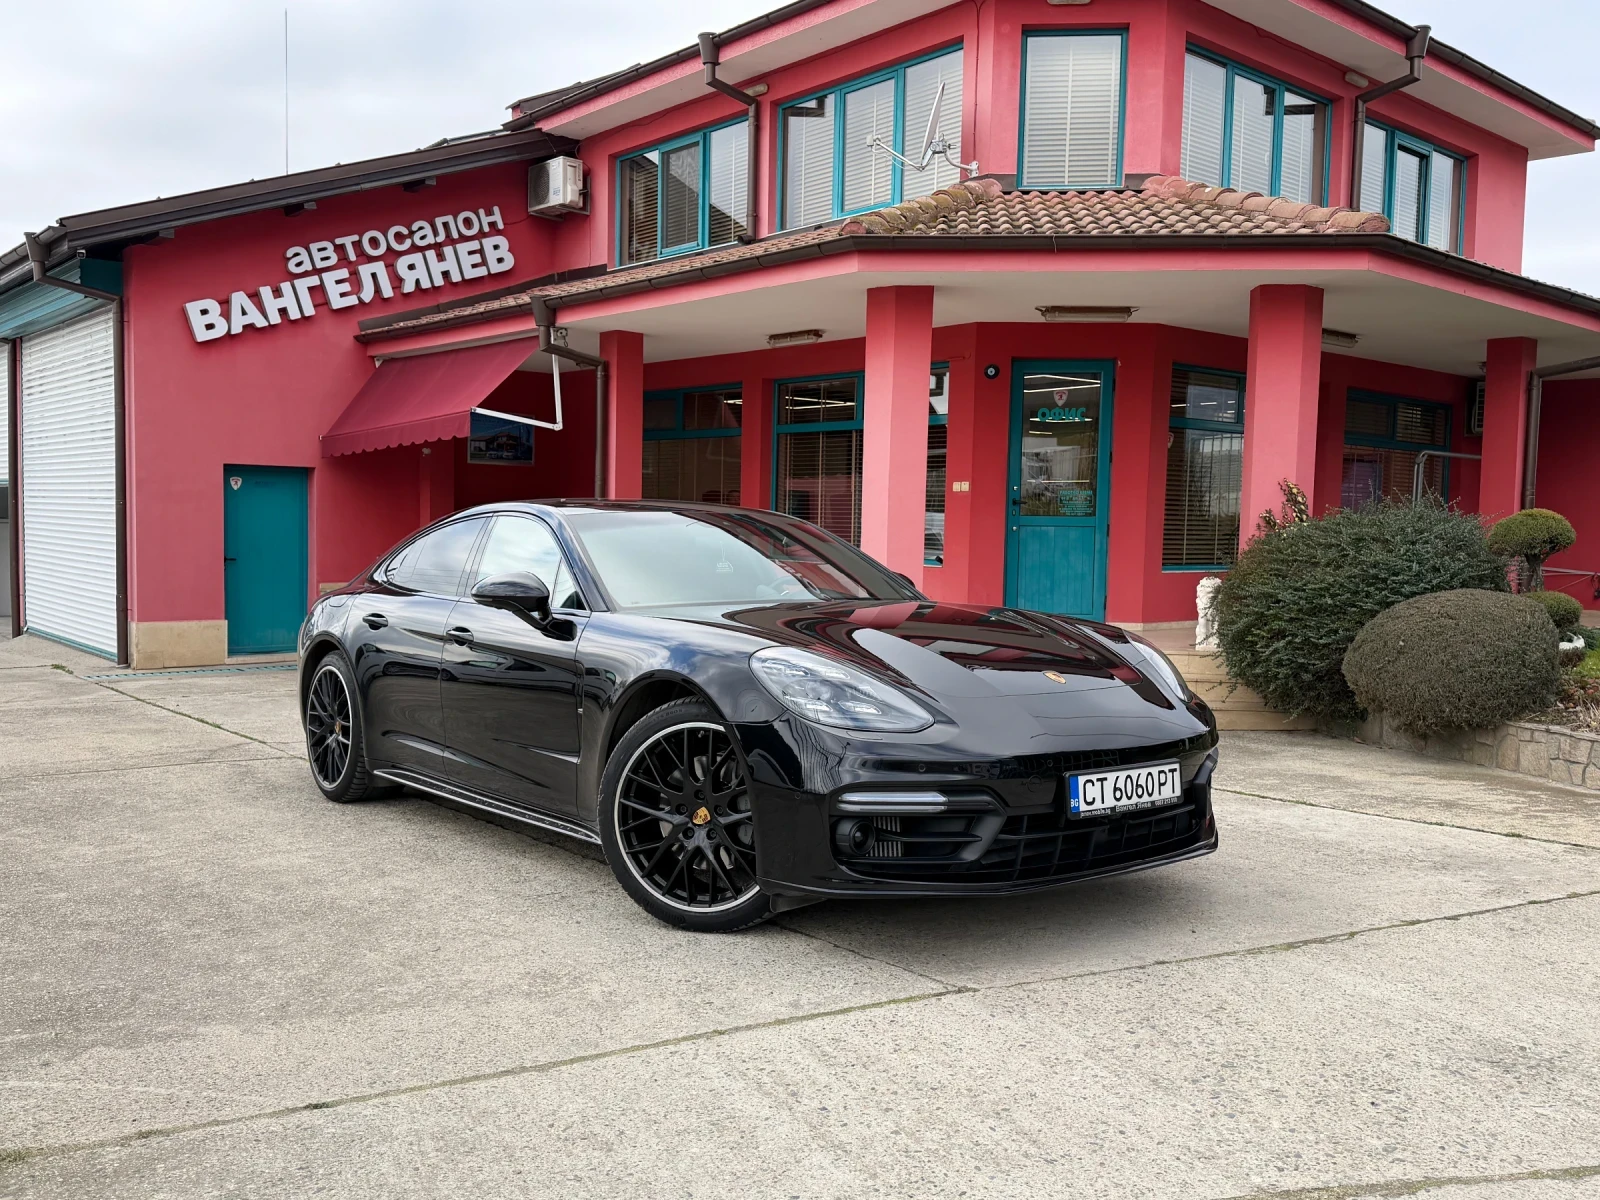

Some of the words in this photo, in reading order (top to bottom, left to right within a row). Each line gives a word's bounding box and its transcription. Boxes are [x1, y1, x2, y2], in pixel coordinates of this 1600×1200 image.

[284, 205, 505, 274] автосалон
[183, 260, 395, 342] ВАНГЕЛ
[394, 235, 515, 293] ЯНЕВ
[1037, 407, 1087, 422] ОФИС
[1070, 798, 1079, 808] BG
[1083, 777, 1107, 806] CT
[1113, 771, 1155, 802] 6060
[1158, 768, 1178, 796] PT
